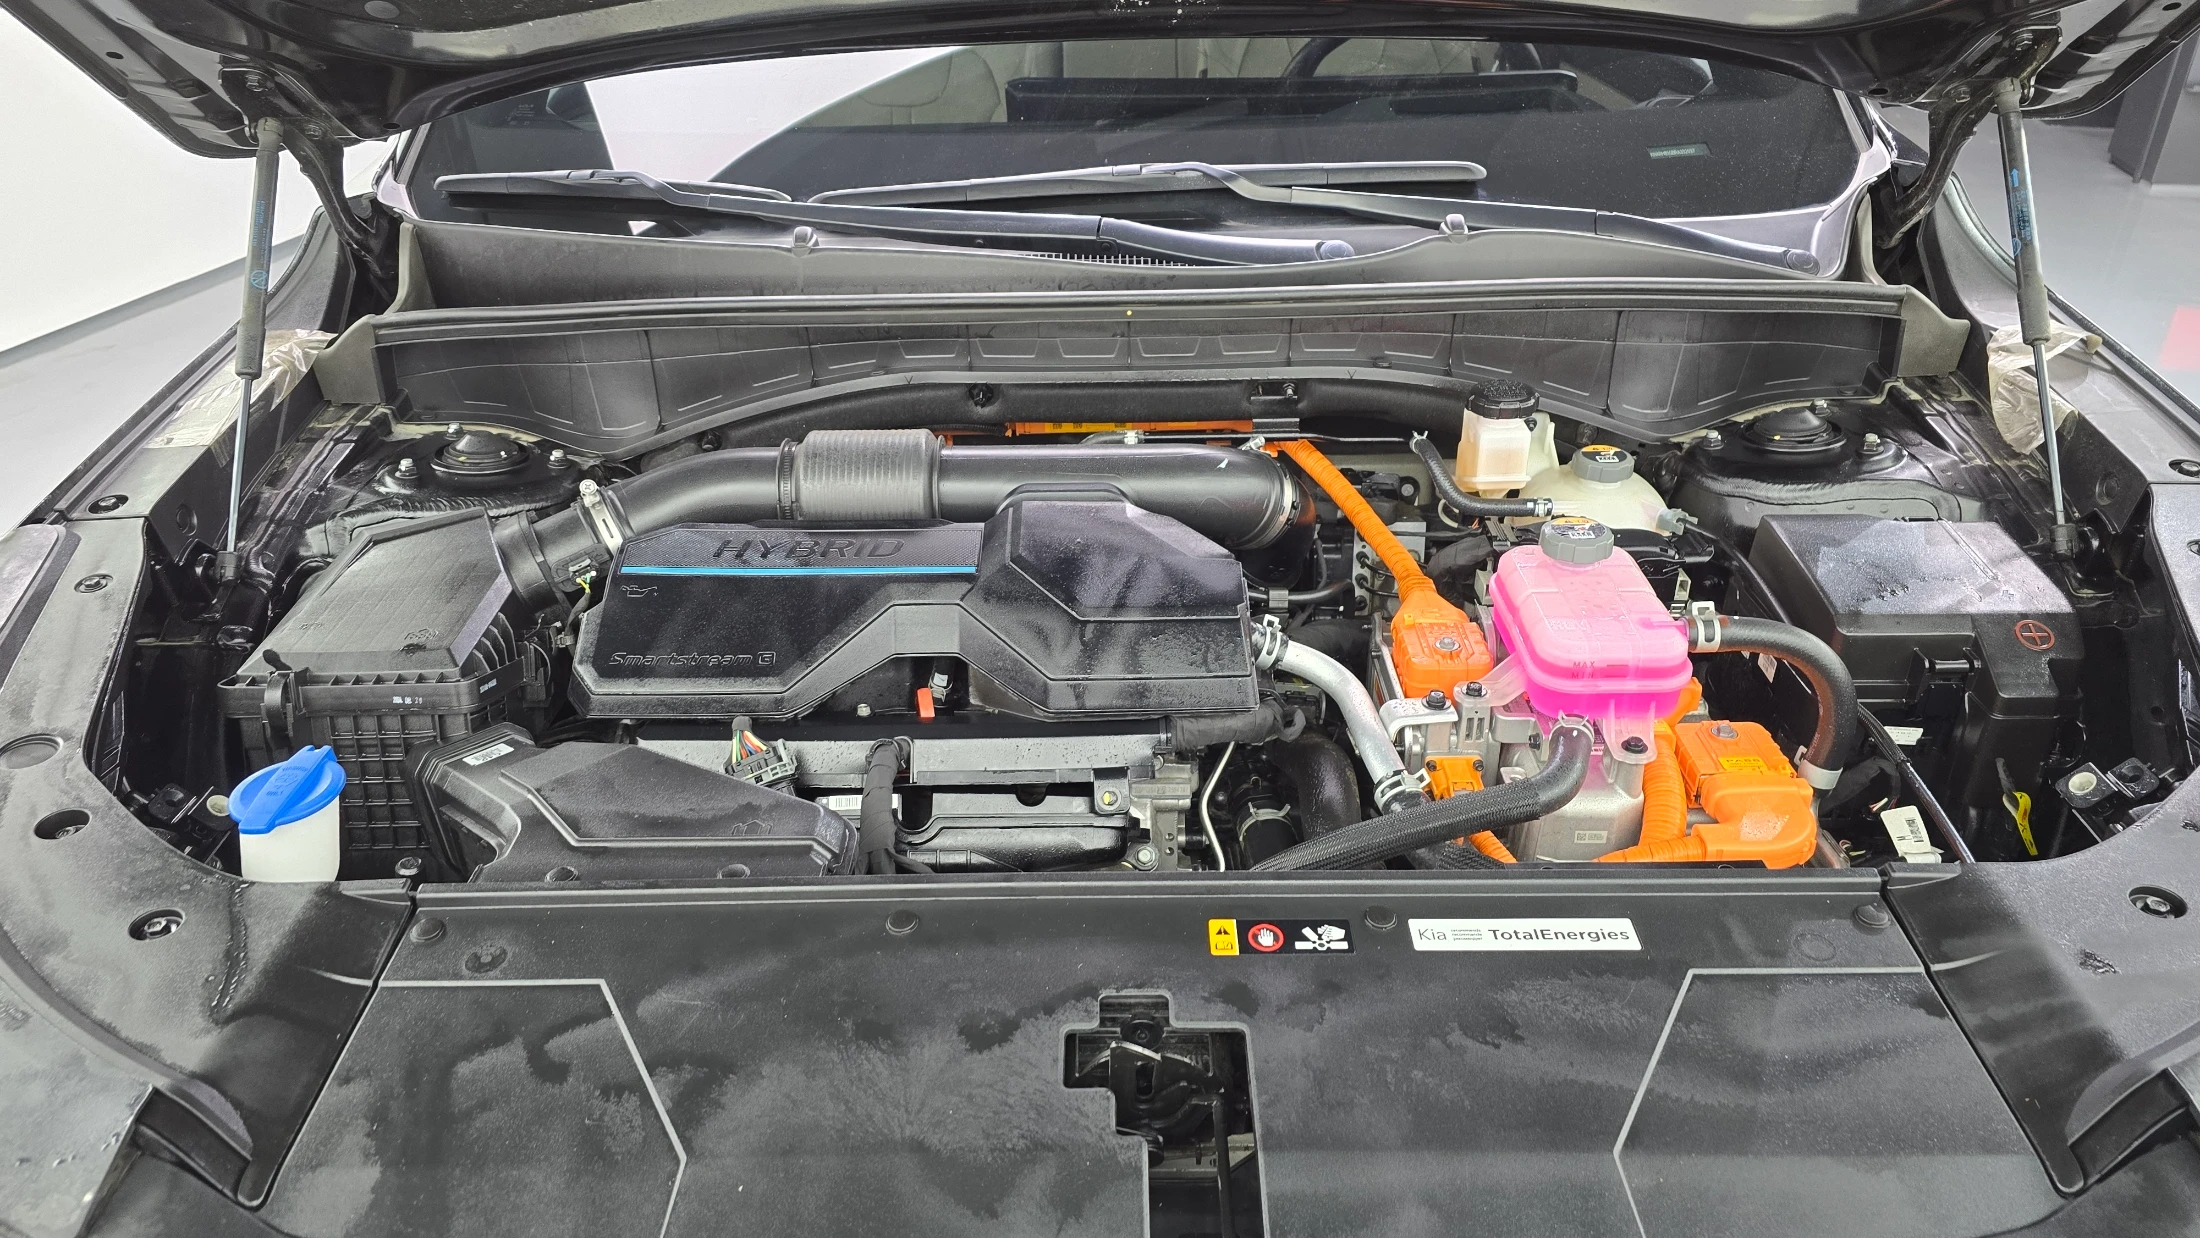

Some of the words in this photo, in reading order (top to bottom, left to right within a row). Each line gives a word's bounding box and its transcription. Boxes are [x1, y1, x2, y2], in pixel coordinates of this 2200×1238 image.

[712, 538, 905, 560] HYBRID
[609, 651, 753, 667] Smartstream
[1572, 660, 1596, 669] MAX
[1571, 671, 1595, 680] MIN
[1417, 928, 1448, 941] Kia
[1487, 928, 1631, 943] TotalEnergies
